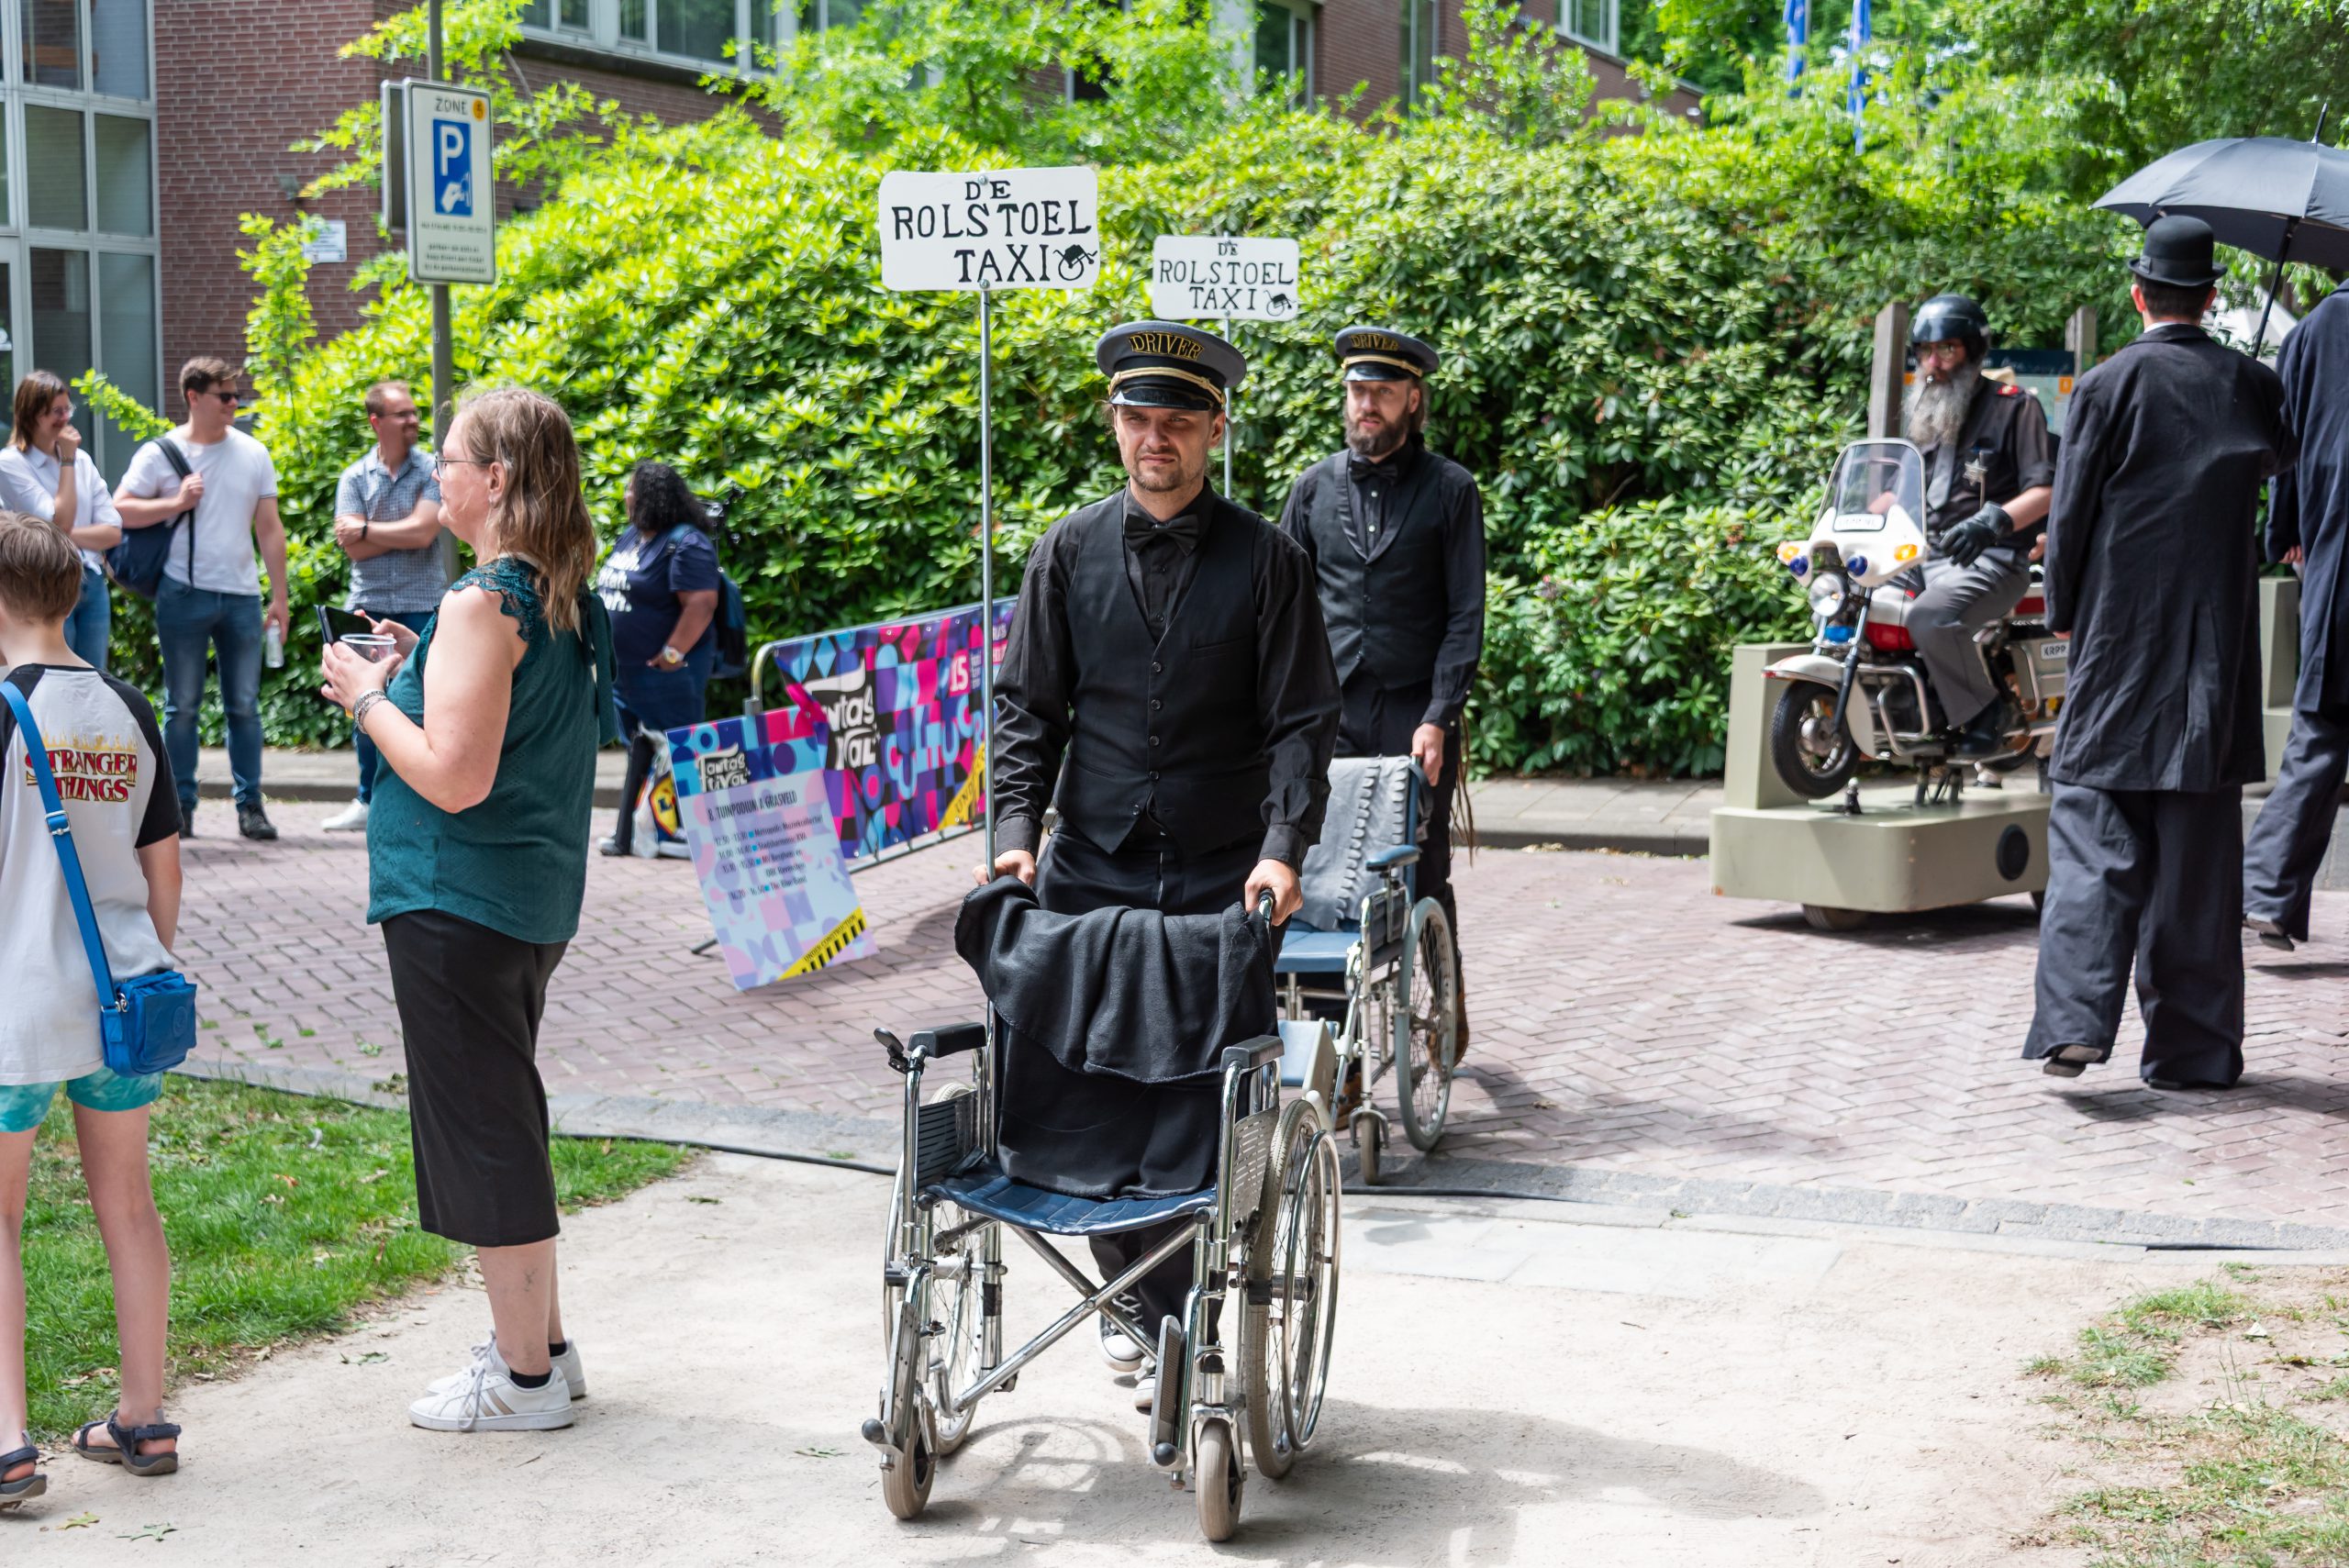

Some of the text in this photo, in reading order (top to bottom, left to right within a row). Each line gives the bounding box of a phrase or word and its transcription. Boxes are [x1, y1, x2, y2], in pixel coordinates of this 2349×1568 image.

[435, 97, 468, 116] ZONE
[440, 125, 464, 176] P
[965, 180, 1011, 200] DE
[891, 200, 1092, 240] ROLSTOEL
[1218, 242, 1239, 256] DE
[954, 244, 1050, 283] TAXI
[1160, 260, 1294, 285] ROLSTOEL
[1189, 286, 1257, 310] TAXI
[1130, 332, 1202, 360] DRIVER
[1351, 334, 1399, 350] DRIVER
[950, 656, 969, 692] 15
[765, 791, 797, 808] GRASVELD
